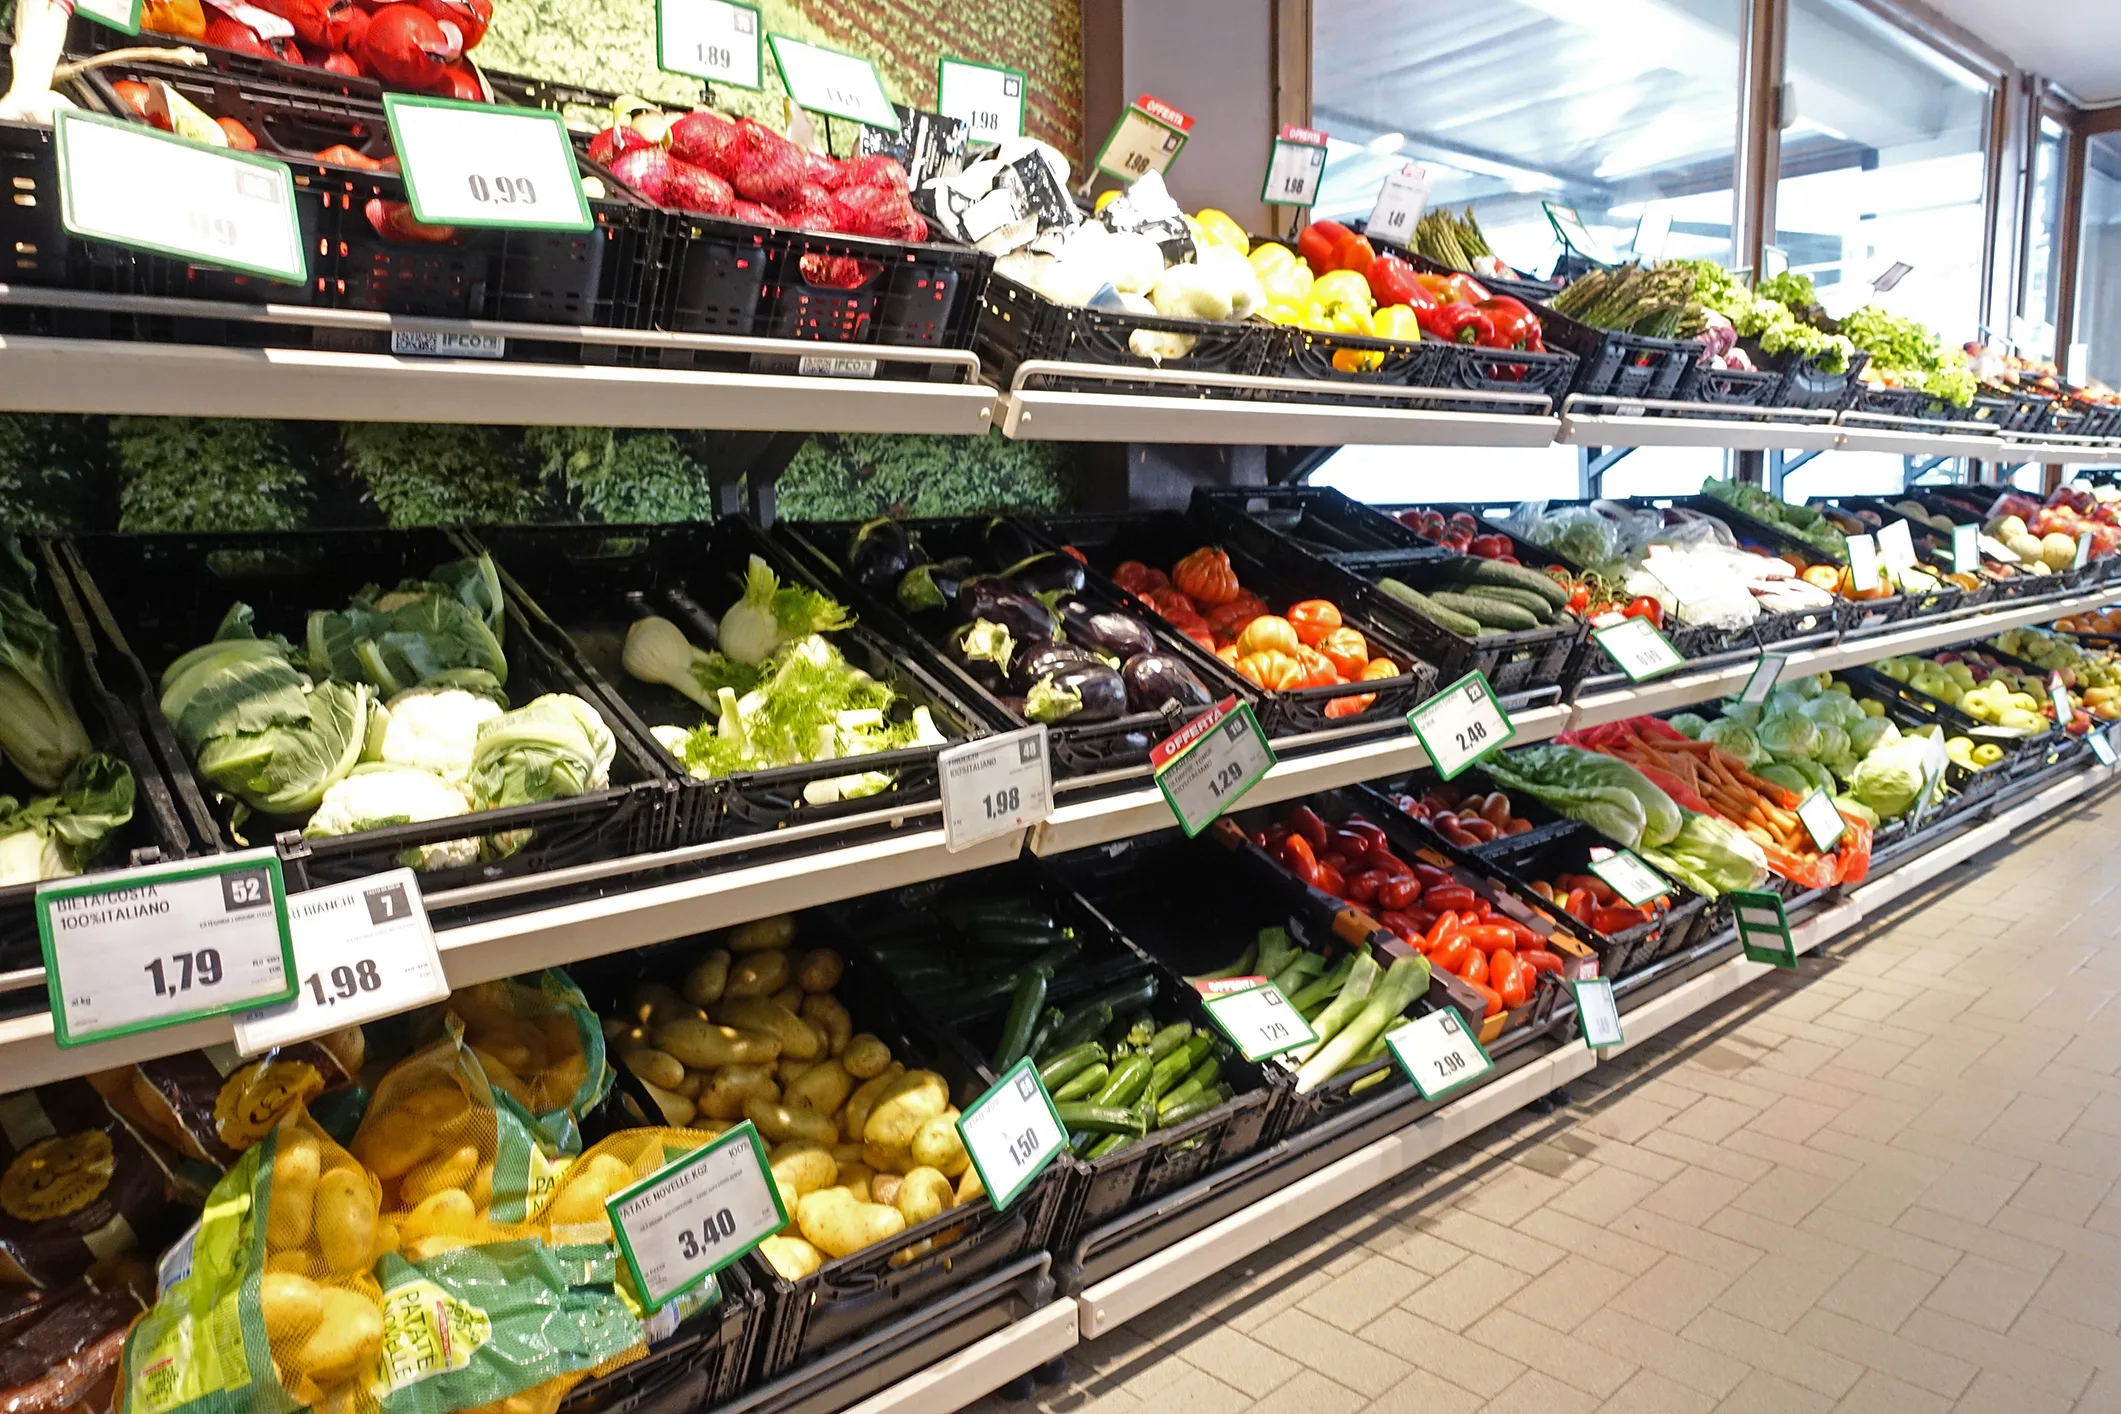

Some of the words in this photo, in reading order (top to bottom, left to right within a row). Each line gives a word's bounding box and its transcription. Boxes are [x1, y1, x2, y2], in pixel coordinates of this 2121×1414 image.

[1146, 100, 1185, 127] OFFERTA
[468, 174, 537, 204] 0,99
[1165, 708, 1224, 755] OFFERTA
[1456, 721, 1487, 752] 2,48
[1208, 762, 1243, 798] 1,29
[983, 786, 1020, 820] 1,98
[57, 885, 158, 912] BIETA/COSTA
[231, 878, 261, 904] 52
[304, 895, 355, 917] BIANCHI
[380, 895, 394, 916] 7
[61, 900, 170, 930] 100%ITALIANO
[144, 948, 223, 999] 1,79
[304, 959, 382, 1007] 1,98
[1434, 1052, 1466, 1077] 2,98
[1008, 1127, 1040, 1166] 1,50
[653, 1174, 691, 1203] NOVELLE
[678, 1208, 736, 1261] 3,40
[398, 1290, 436, 1373] PATATE
